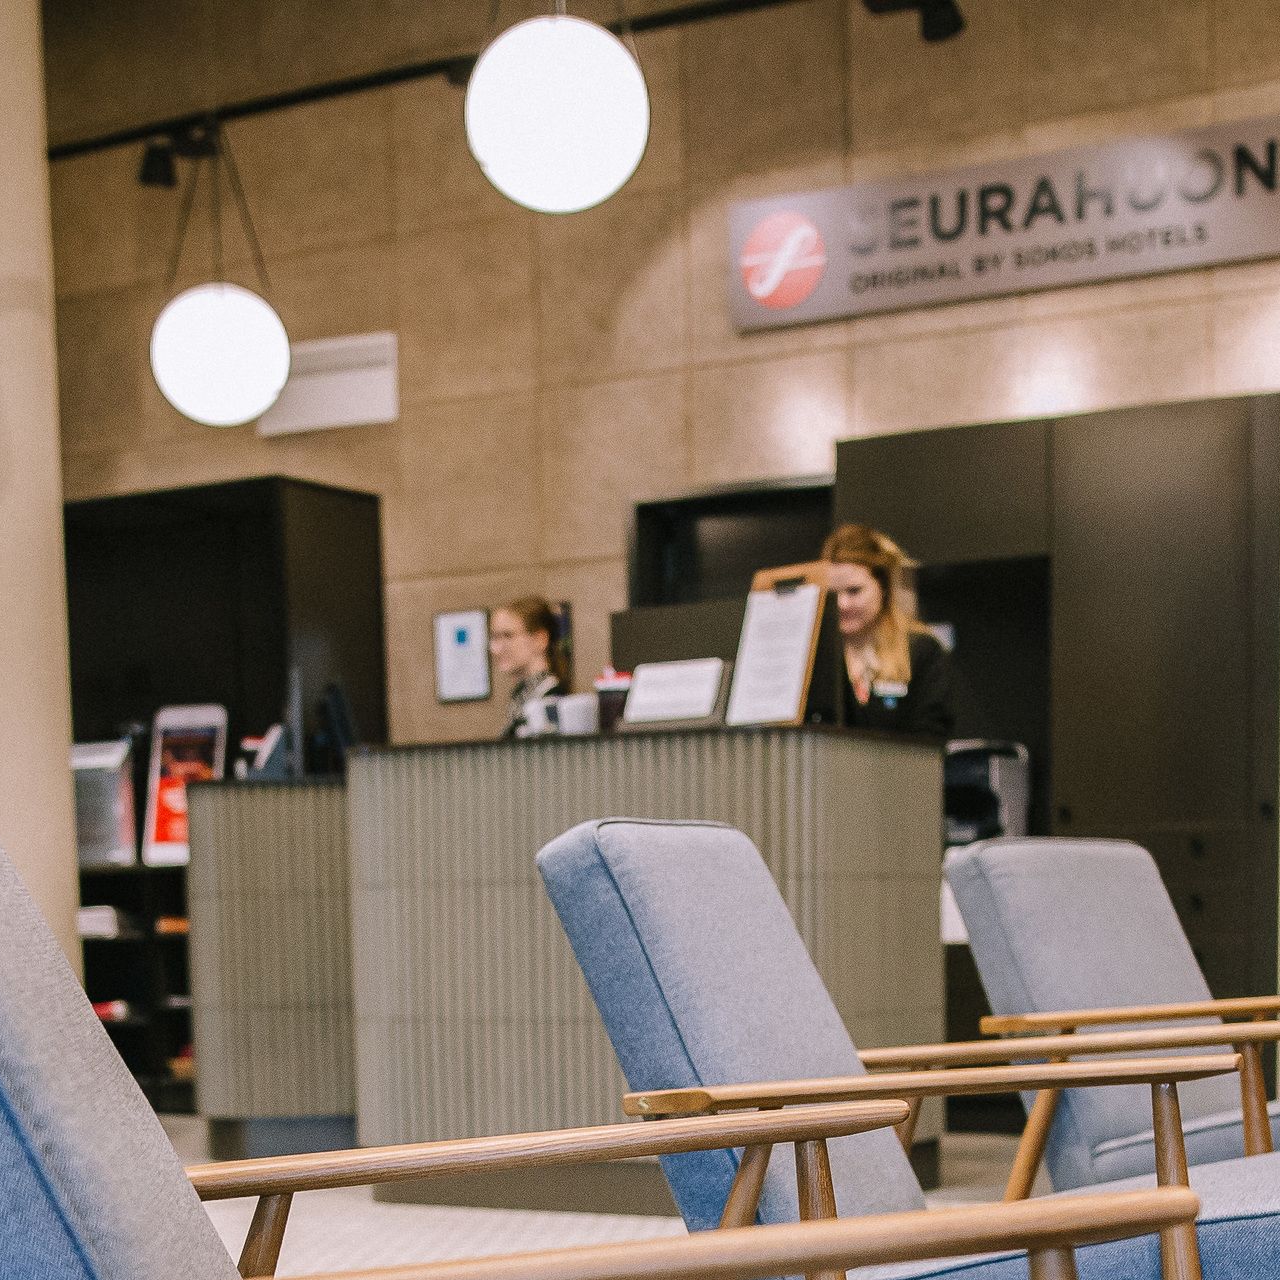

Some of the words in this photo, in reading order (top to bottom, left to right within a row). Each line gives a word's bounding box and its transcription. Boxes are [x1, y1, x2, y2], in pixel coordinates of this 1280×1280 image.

[849, 261, 962, 294] ORIGINAL
[971, 252, 1005, 276] BY
[1013, 237, 1098, 270] SOKOS
[1104, 220, 1209, 256] HOTELS
